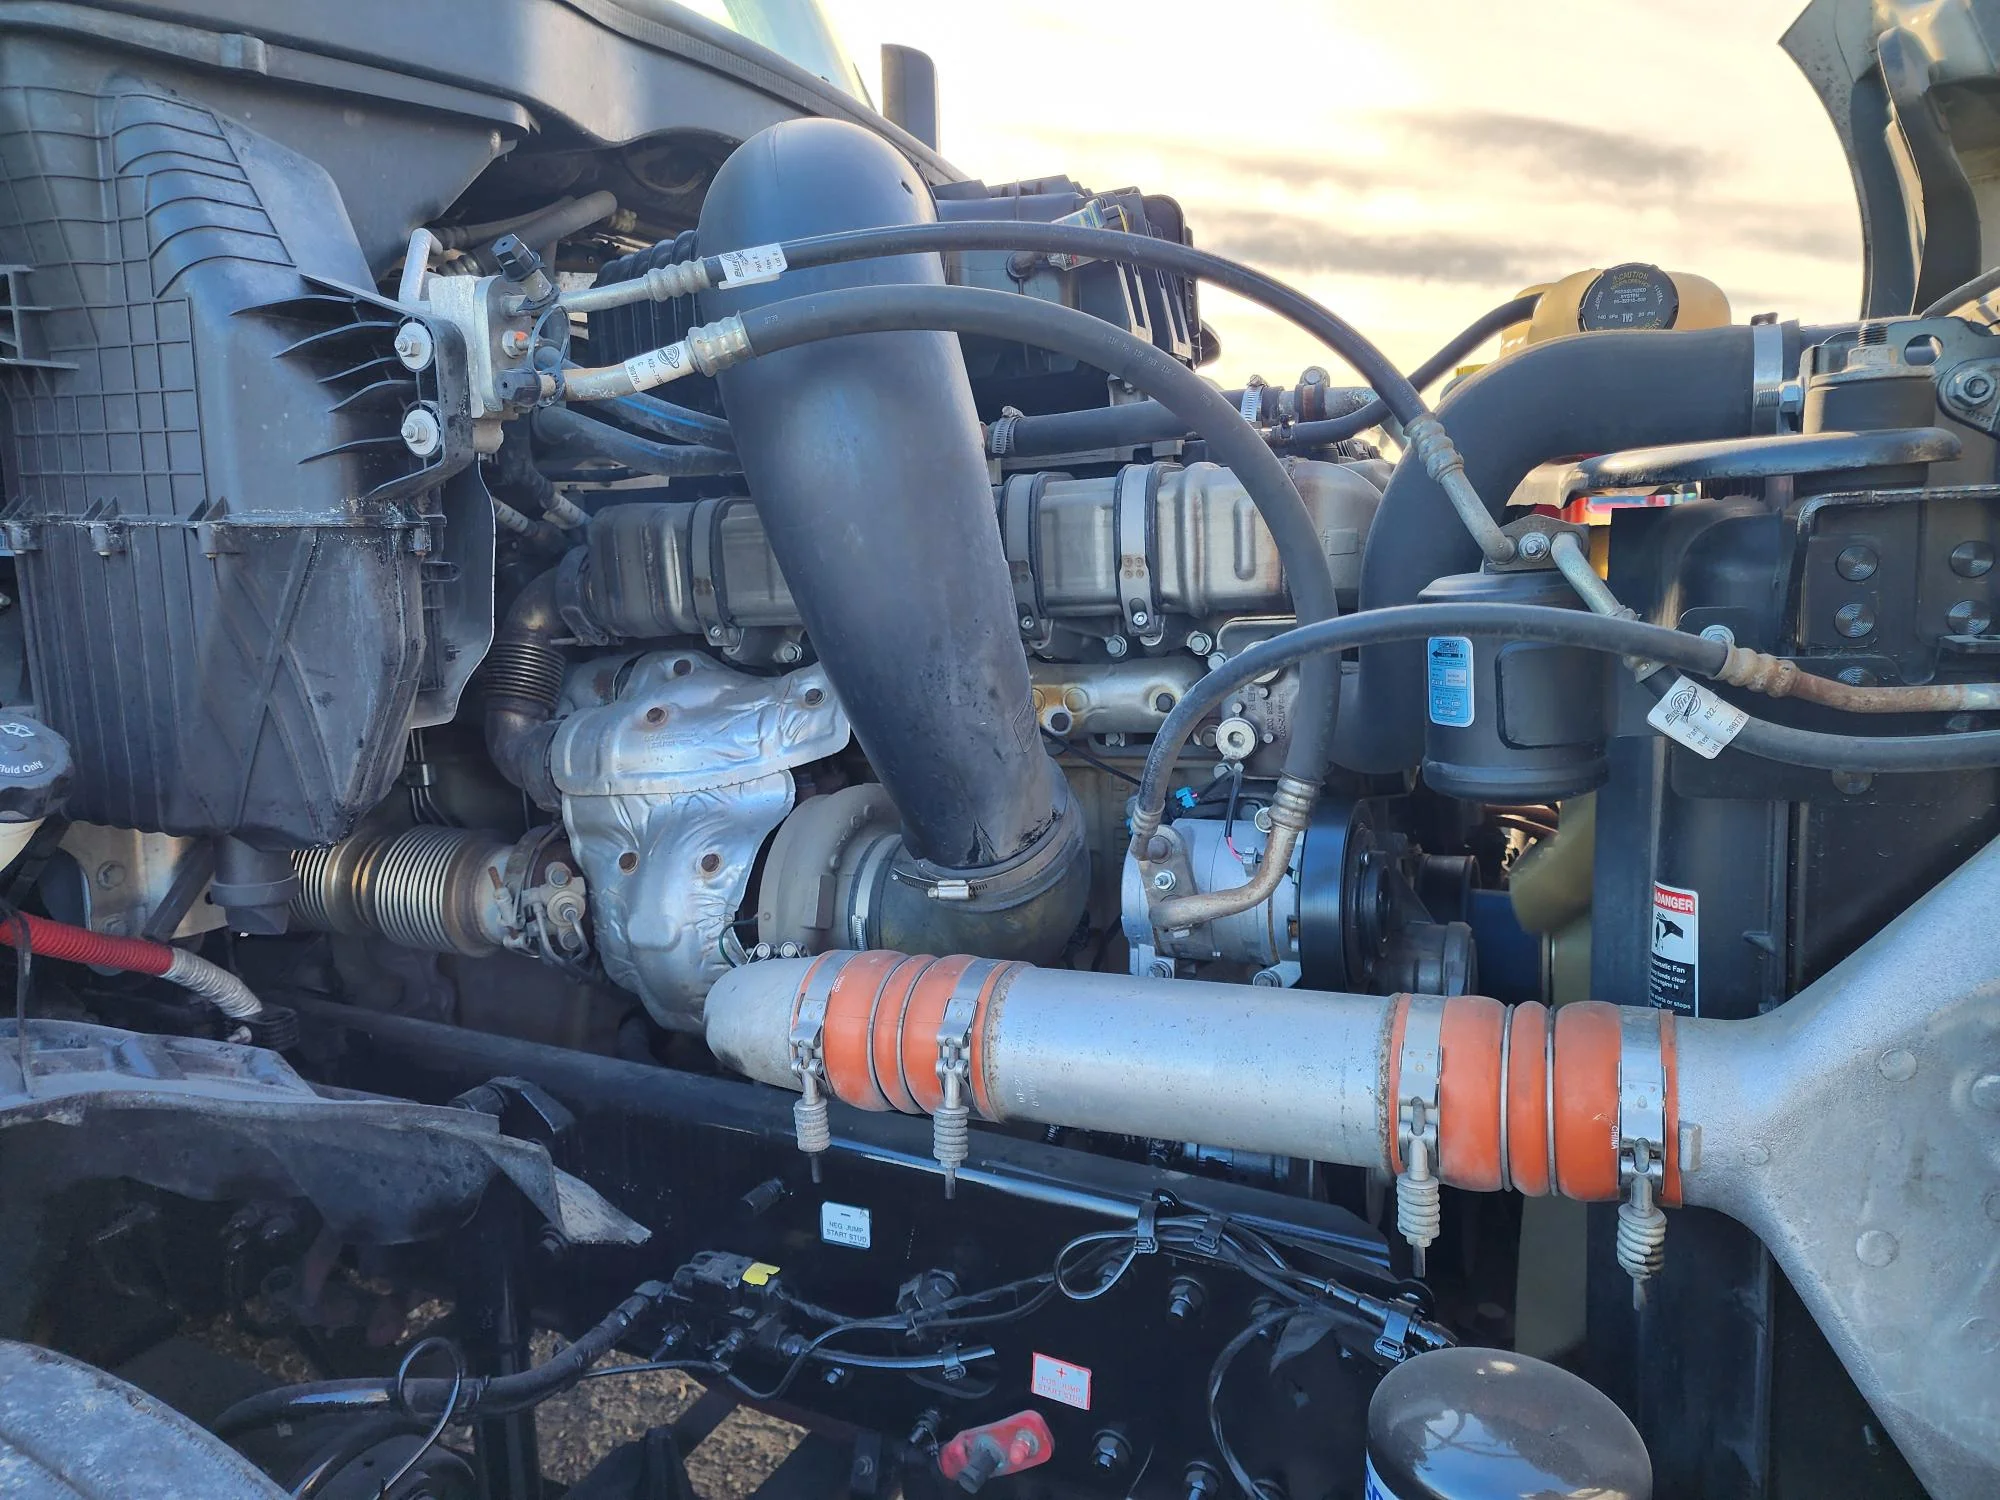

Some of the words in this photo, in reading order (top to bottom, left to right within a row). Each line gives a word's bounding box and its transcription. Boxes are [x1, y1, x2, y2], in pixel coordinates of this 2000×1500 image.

[1618, 271, 1648, 281] CAUTION
[23, 760, 44, 773] Only
[1656, 892, 1694, 912] DANGER
[1673, 965, 1685, 974] Fan
[1674, 1001, 1691, 1009] stops
[1611, 1125, 1619, 1149] CHINA
[846, 1225, 864, 1233] JUMP
[826, 1228, 847, 1238] START
[849, 1233, 867, 1243] STUD
[1040, 1385, 1061, 1395] START
[1065, 1392, 1082, 1402] STUD
[1064, 1384, 1080, 1393] JUMP
